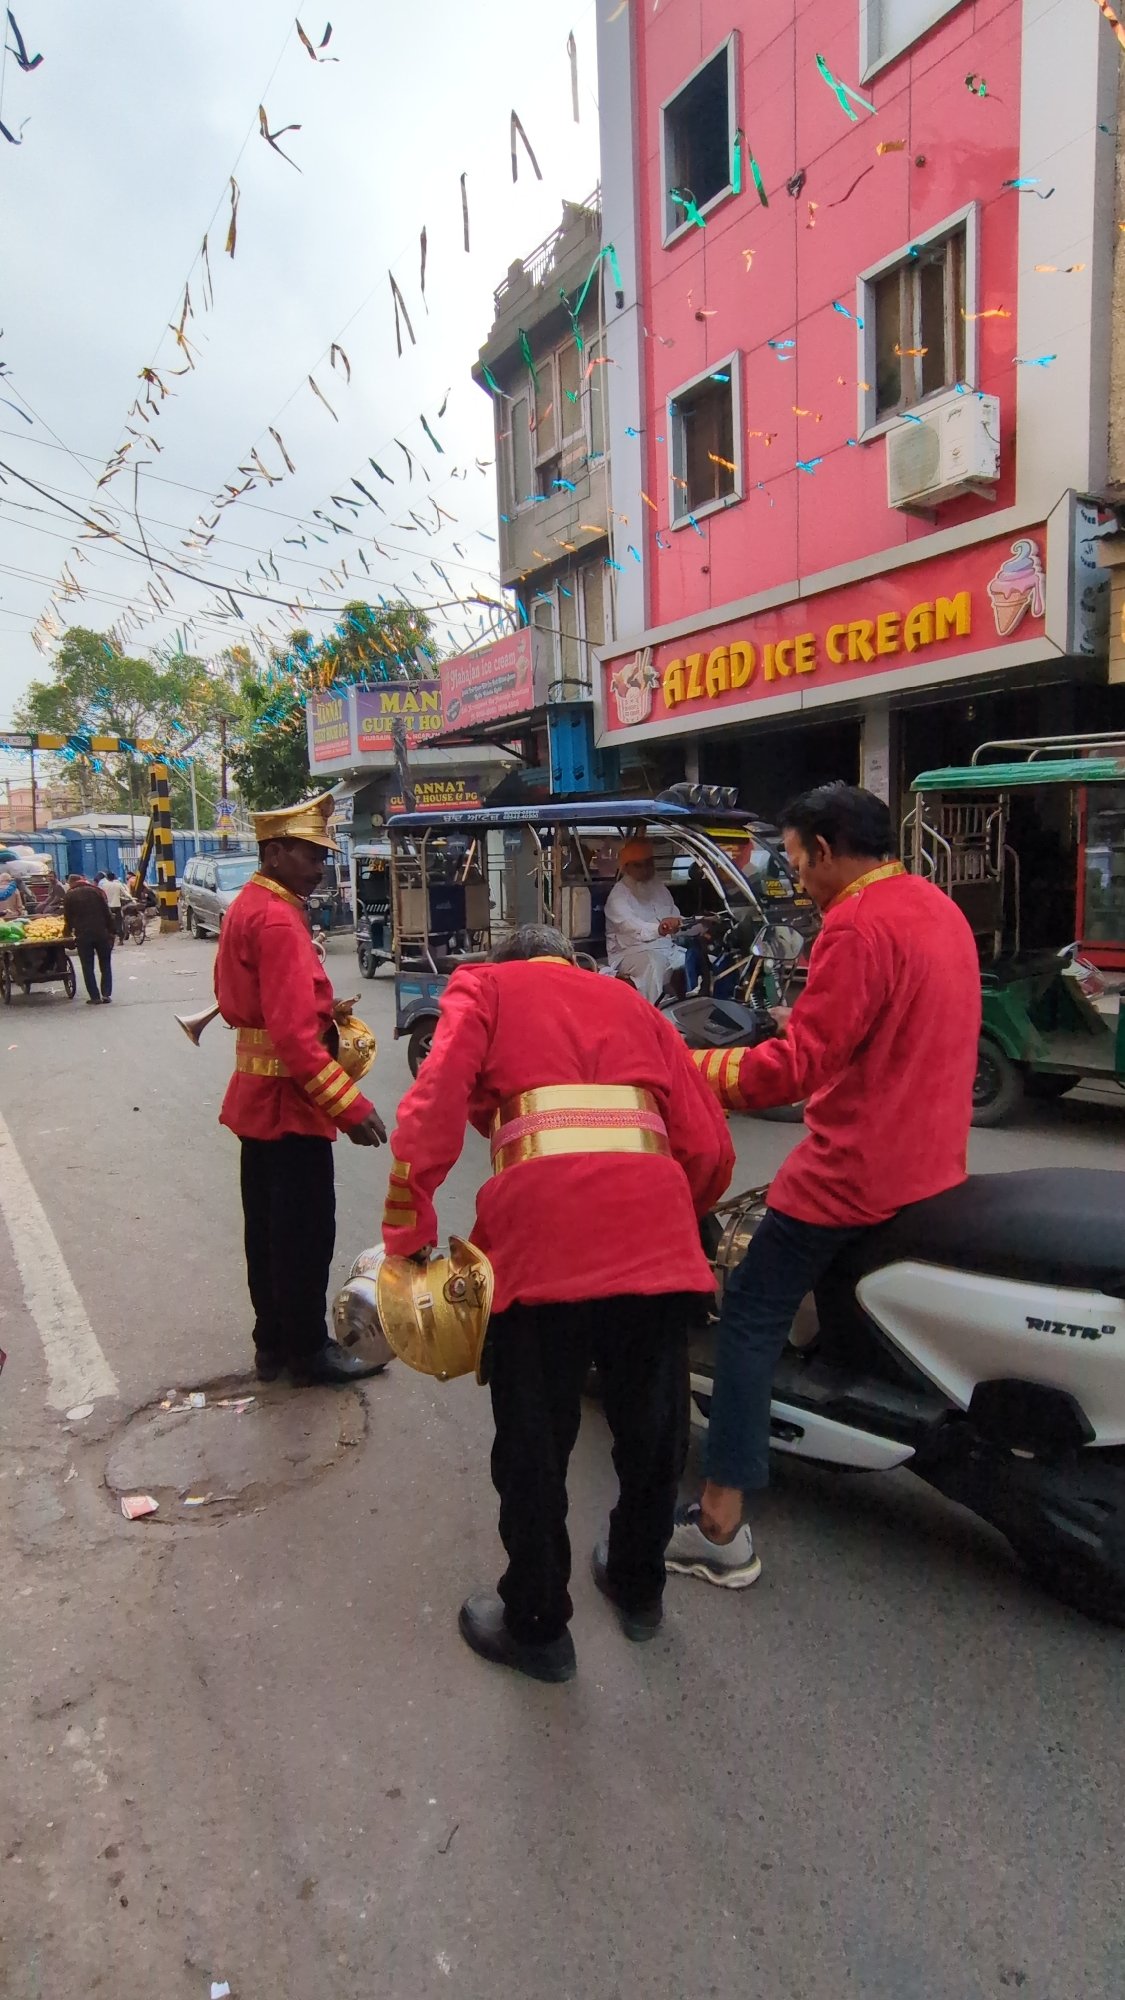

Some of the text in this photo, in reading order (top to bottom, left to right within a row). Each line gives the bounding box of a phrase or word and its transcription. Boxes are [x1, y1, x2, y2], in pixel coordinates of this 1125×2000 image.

[663, 591, 971, 709] AZAD ICE CREAM
[380, 690, 442, 713] MAN
[362, 715, 414, 732] GUET
[414, 781, 465, 795] ANNAT
[423, 793, 454, 803] HOUSE
[456, 792, 462, 801] &
[465, 791, 478, 801] PG
